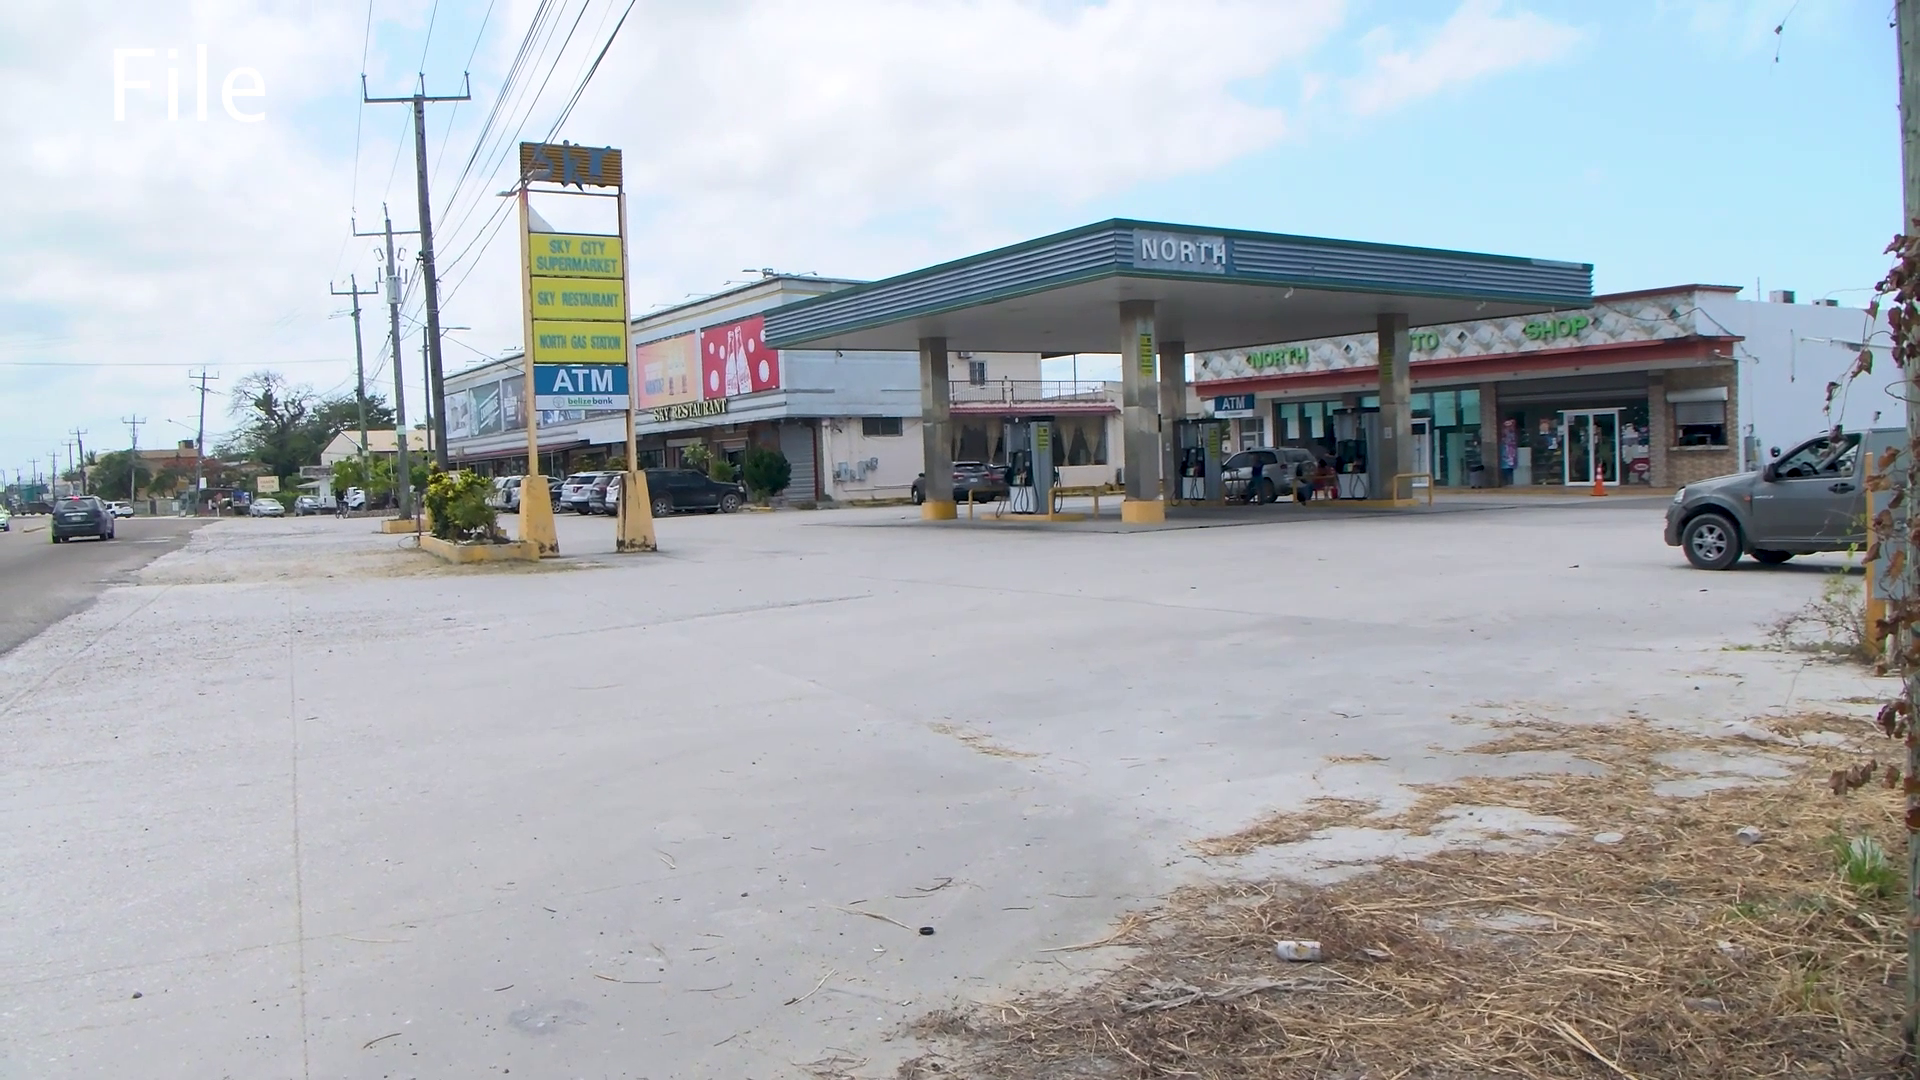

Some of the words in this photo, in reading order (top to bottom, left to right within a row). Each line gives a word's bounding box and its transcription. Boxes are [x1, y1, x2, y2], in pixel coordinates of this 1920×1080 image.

[549, 239, 571, 254] SKY
[580, 241, 606, 256] CITY
[1141, 238, 1227, 265] NORTH
[536, 256, 618, 273] SUPERMARKET
[537, 291, 555, 306] SKY
[561, 292, 619, 307] RESTAURANT
[539, 334, 567, 349] NORTH
[571, 334, 587, 350] GAS
[590, 335, 621, 350] STATION
[1250, 346, 1309, 368] NORTH
[1525, 315, 1589, 341] SHOP
[552, 368, 614, 392] ATM
[653, 407, 670, 422] SKY
[672, 398, 727, 419] RESTAURANT
[1221, 396, 1246, 410] ATM
